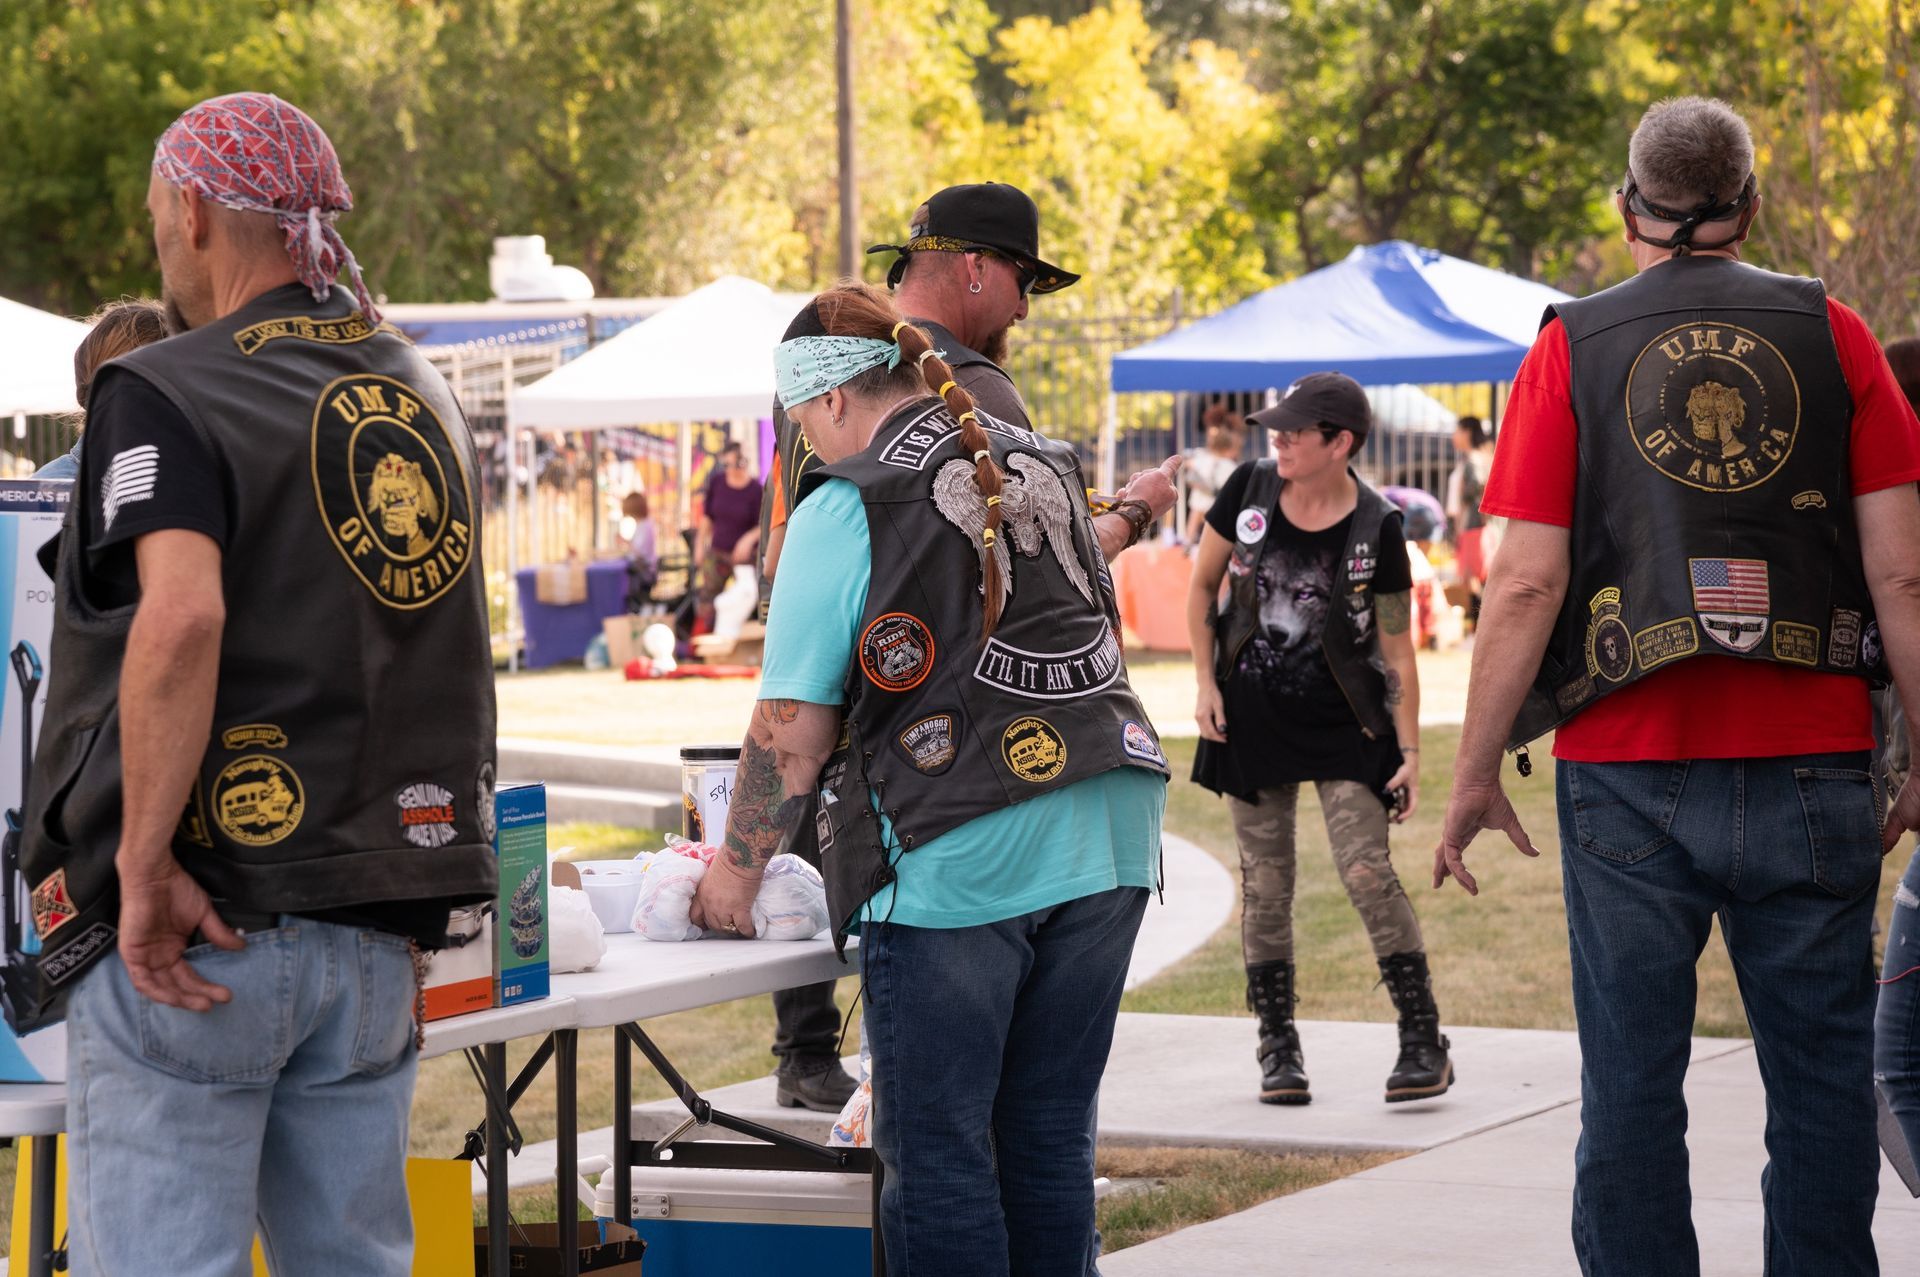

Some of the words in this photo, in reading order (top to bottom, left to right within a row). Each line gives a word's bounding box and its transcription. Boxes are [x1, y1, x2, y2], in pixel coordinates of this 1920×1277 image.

[300, 325, 316, 339] IS
[319, 325, 340, 340] AS
[1659, 330, 1756, 361] UMF
[331, 385, 420, 424] UMF
[904, 431, 935, 449] IS
[891, 446, 922, 464] IT
[1645, 429, 1678, 458] OF
[1687, 428, 1789, 485] AMERCA
[338, 516, 373, 557] OF
[379, 519, 469, 599] AMERICA
[1348, 557, 1376, 572] FCK
[877, 628, 906, 647] RIDE
[1020, 660, 1039, 689] IT
[1046, 658, 1090, 690] AIN'T
[904, 719, 949, 747] TIMPANOGOS
[1006, 720, 1043, 739] Naughty
[225, 759, 281, 781] Naughty
[1025, 770, 1052, 780] School
[397, 783, 455, 808] GENUINE
[402, 804, 455, 826] ASSHOLE
